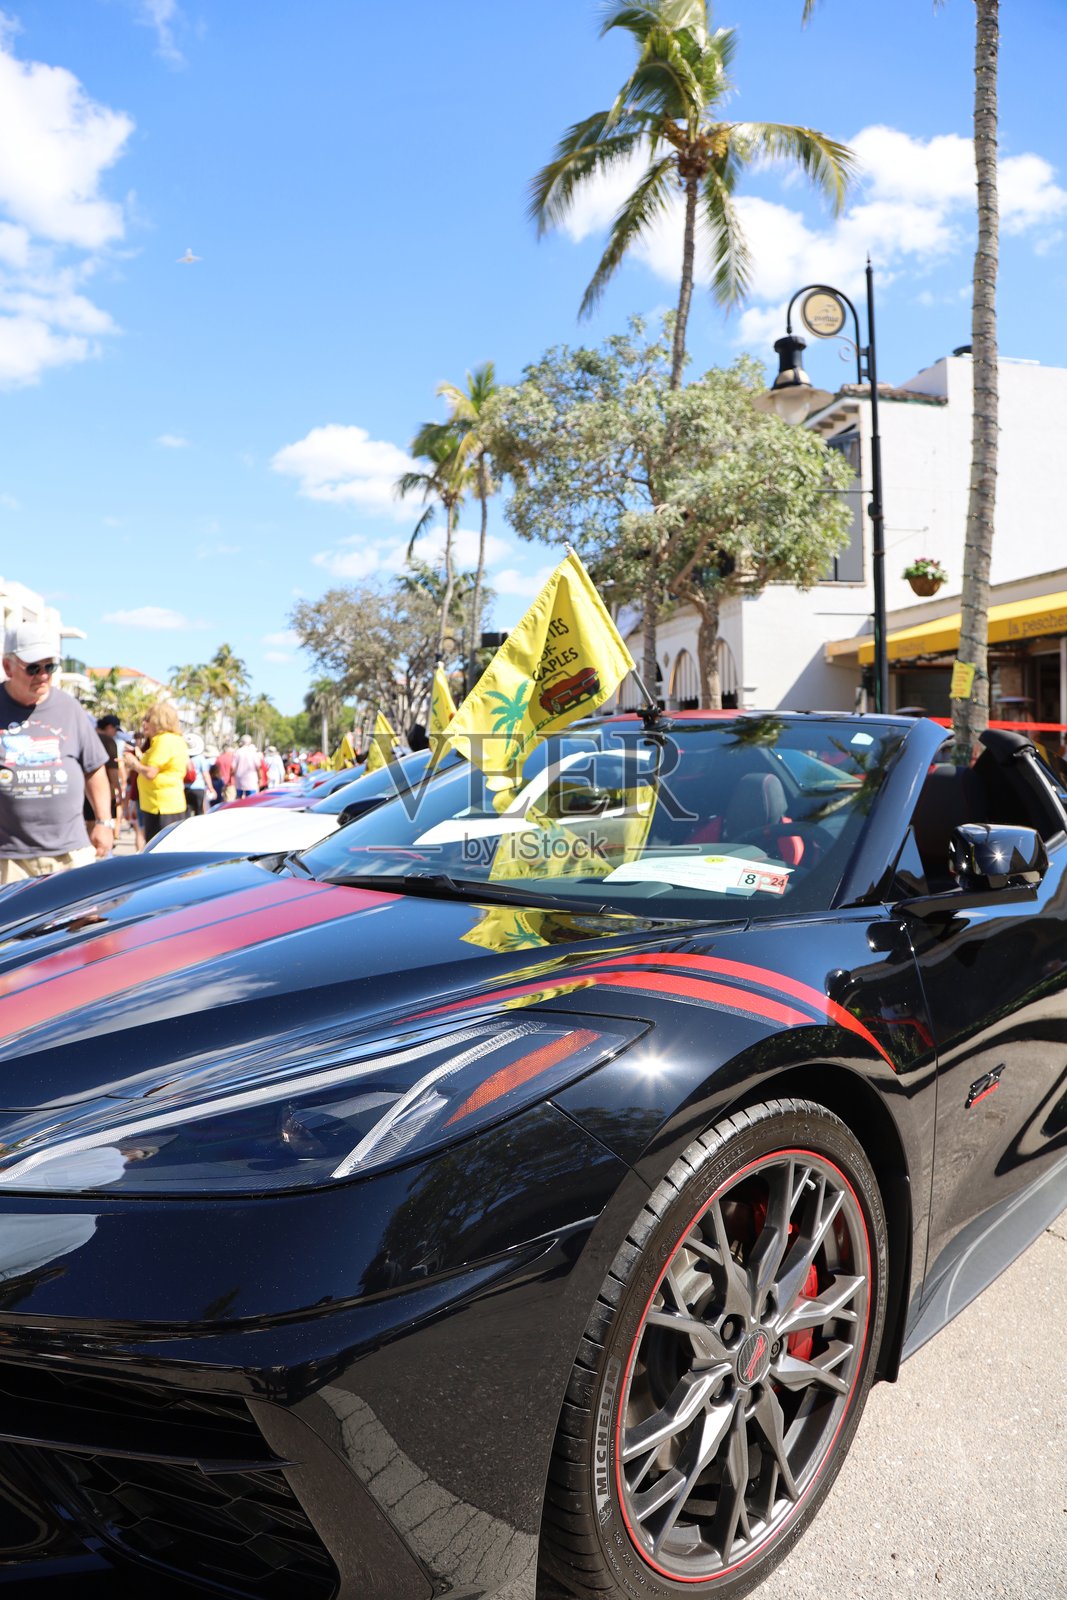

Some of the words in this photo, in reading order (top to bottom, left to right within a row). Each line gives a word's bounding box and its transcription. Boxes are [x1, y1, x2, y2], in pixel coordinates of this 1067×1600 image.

[745, 874, 756, 885] 8
[771, 878, 784, 887] 24
[596, 1363, 619, 1496] MICHELIN
